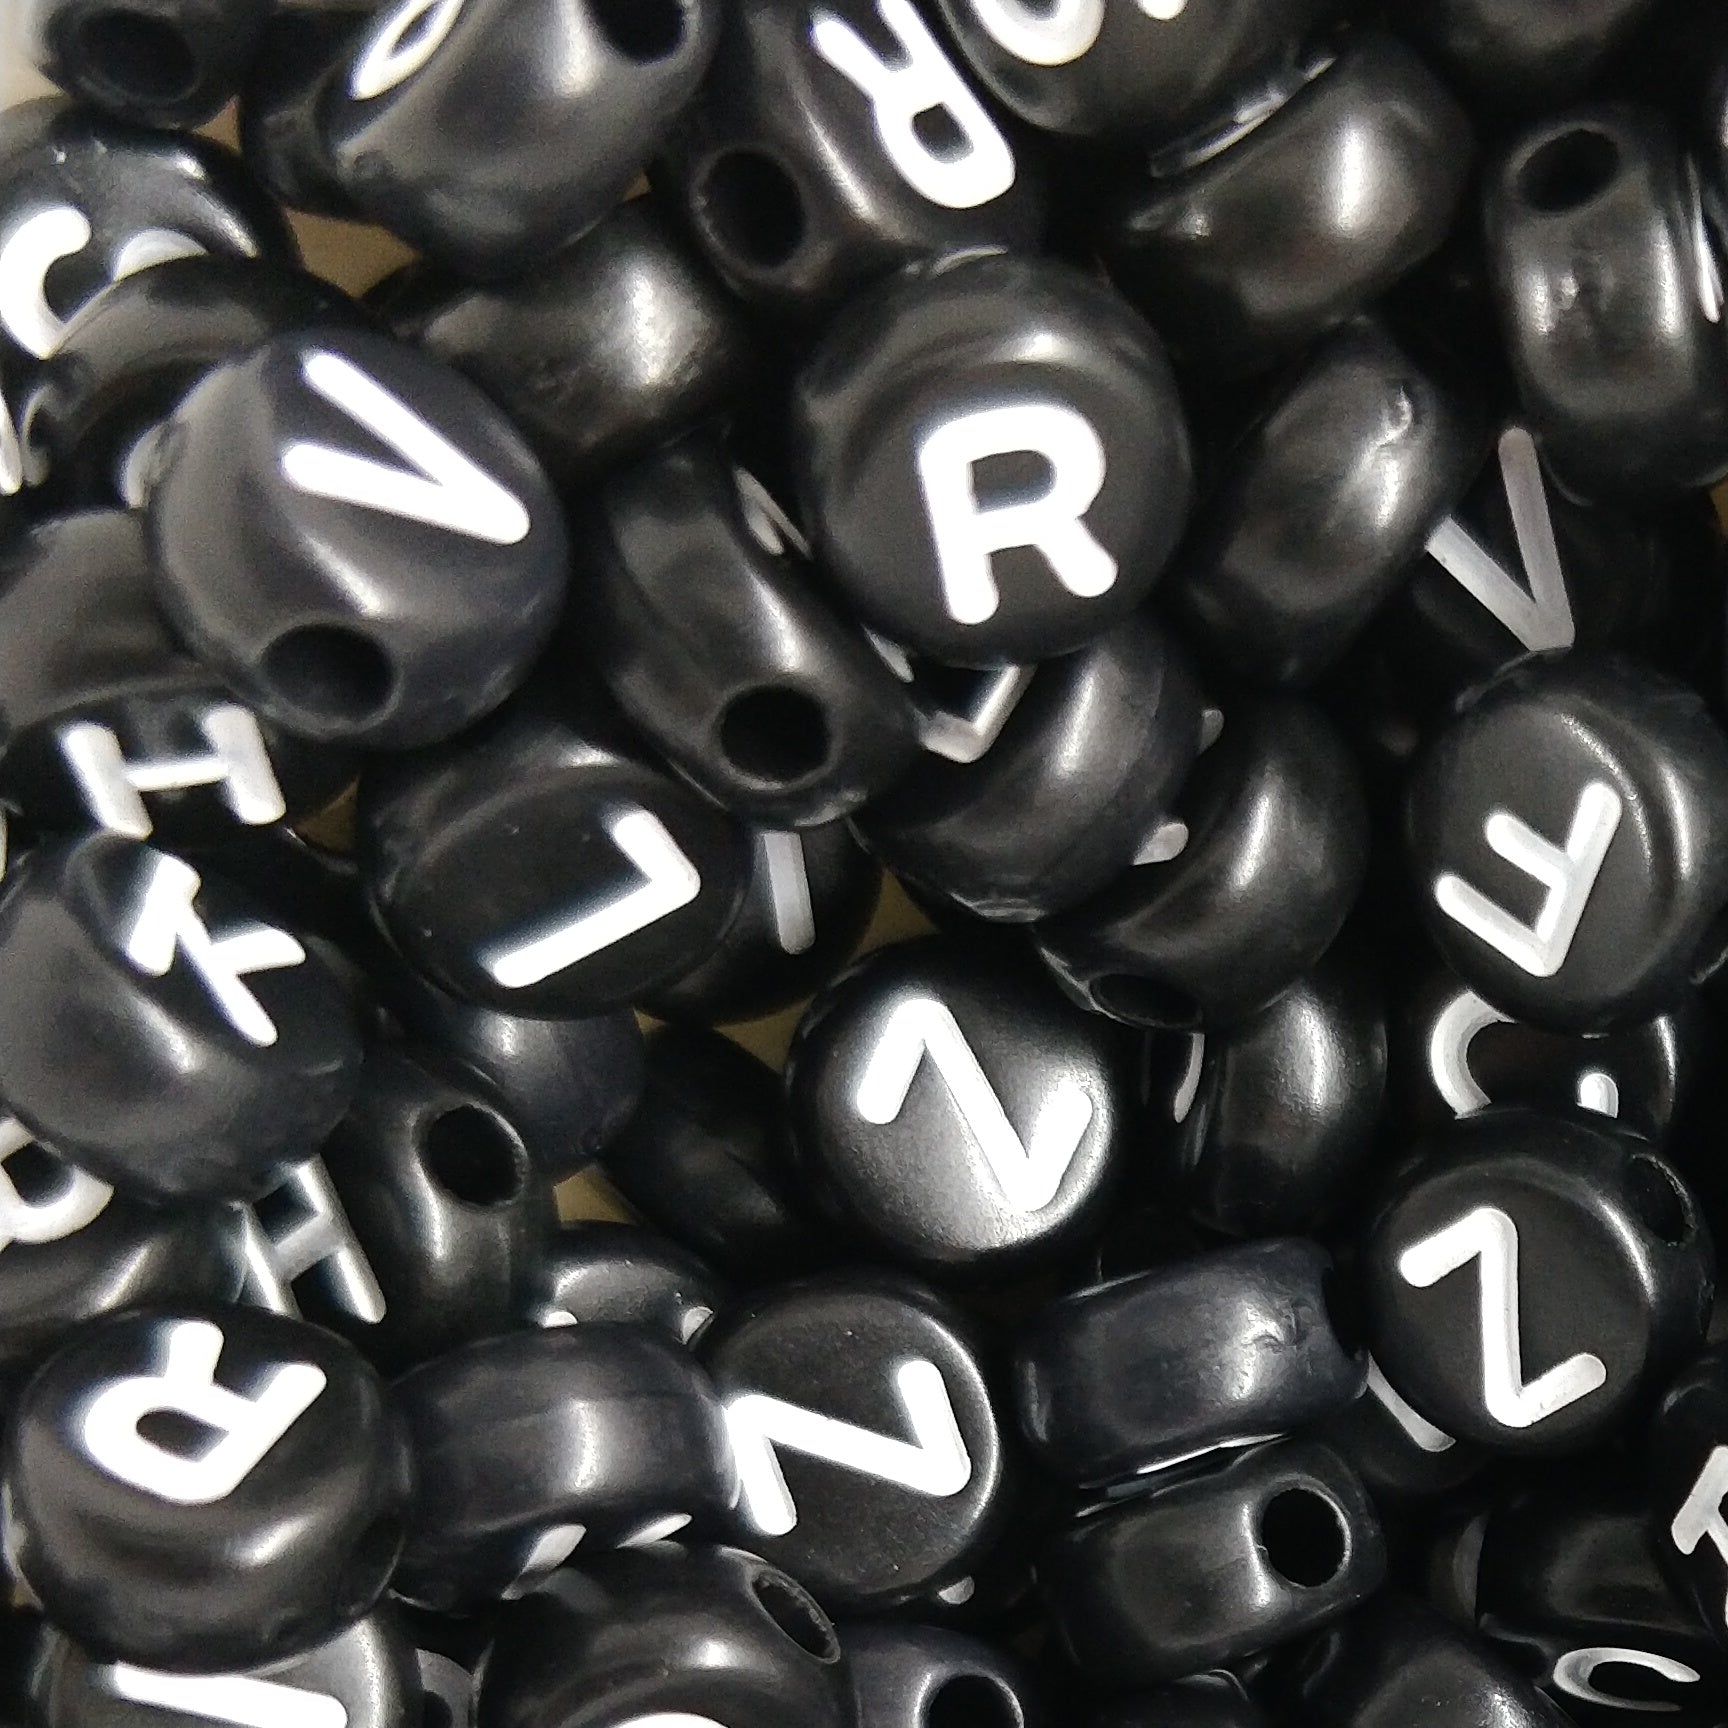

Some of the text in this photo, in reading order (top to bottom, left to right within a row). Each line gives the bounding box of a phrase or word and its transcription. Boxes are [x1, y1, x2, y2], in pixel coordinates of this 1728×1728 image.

[812, 0, 1015, 208] R
[282, 352, 529, 544] V
[917, 402, 1118, 624] R
[1426, 427, 1574, 650] V
[63, 706, 287, 838] H
[124, 854, 305, 1046] K
[487, 810, 700, 988] L
[1436, 781, 1621, 976] F
[855, 996, 1094, 1214] Z
[232, 1161, 384, 1323] H
[1400, 1208, 1606, 1427] Z
[80, 1321, 326, 1504] R
